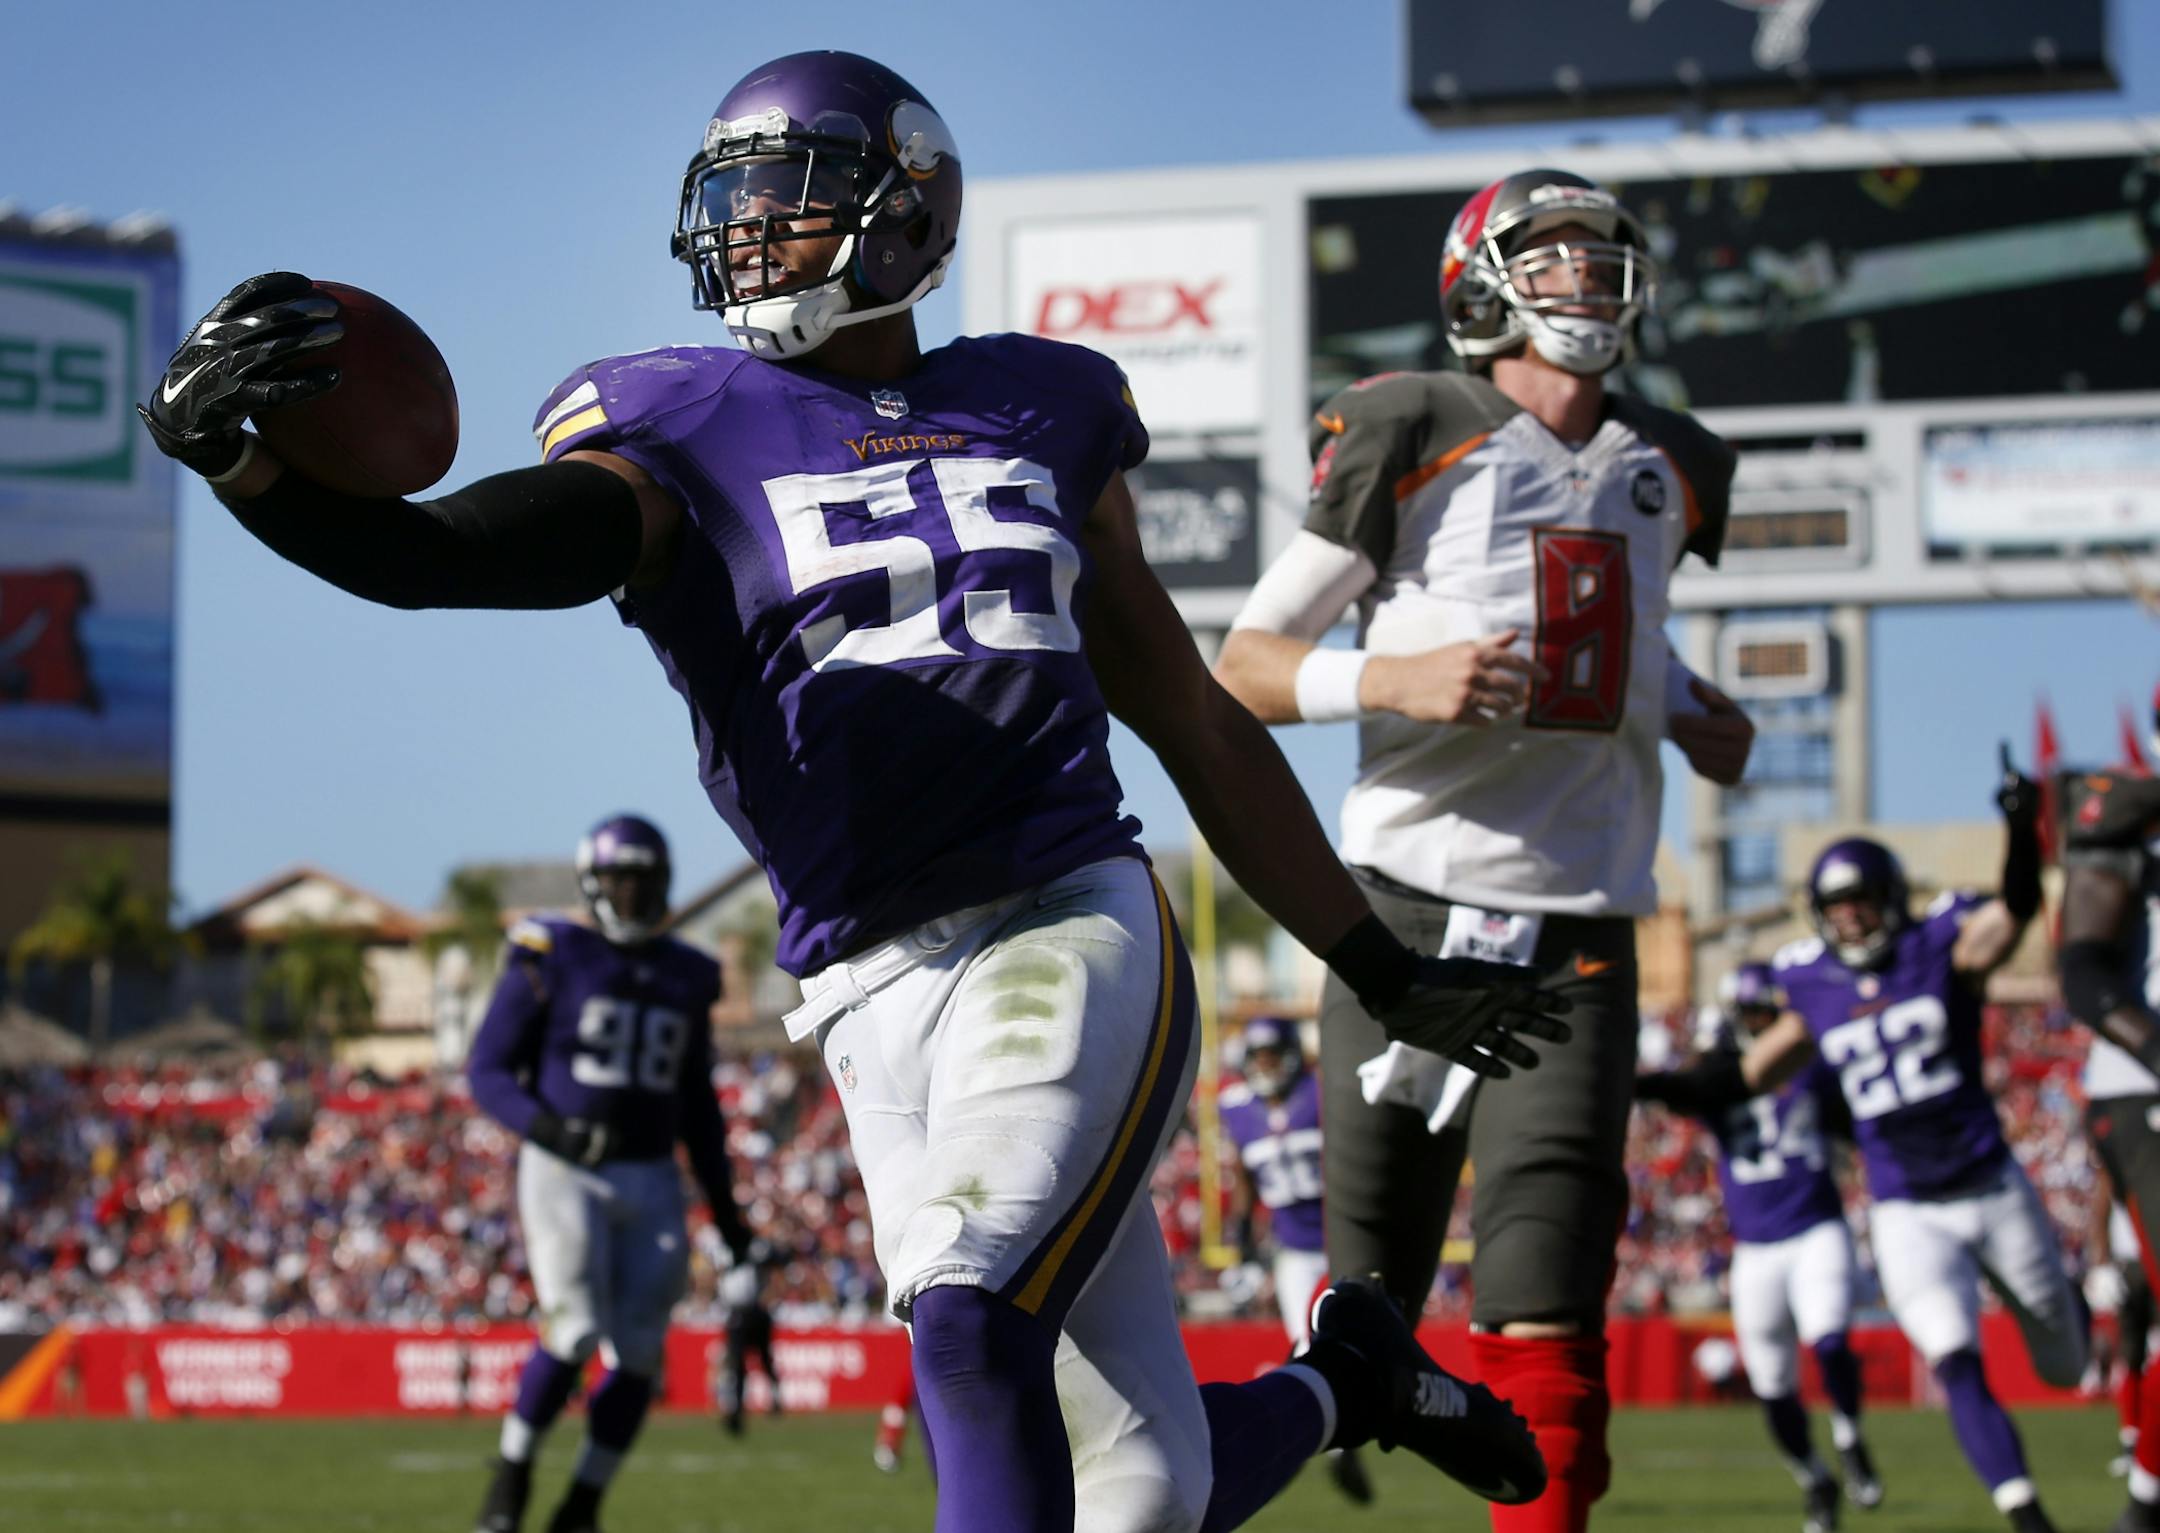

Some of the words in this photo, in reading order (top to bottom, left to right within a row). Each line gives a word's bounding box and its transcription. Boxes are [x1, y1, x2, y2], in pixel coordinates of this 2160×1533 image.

[1033, 276, 1228, 336] DEX
[761, 457, 1081, 674] 55
[1524, 527, 1635, 734] 8
[570, 996, 688, 1088] 98
[1819, 995, 1963, 1121] 22
